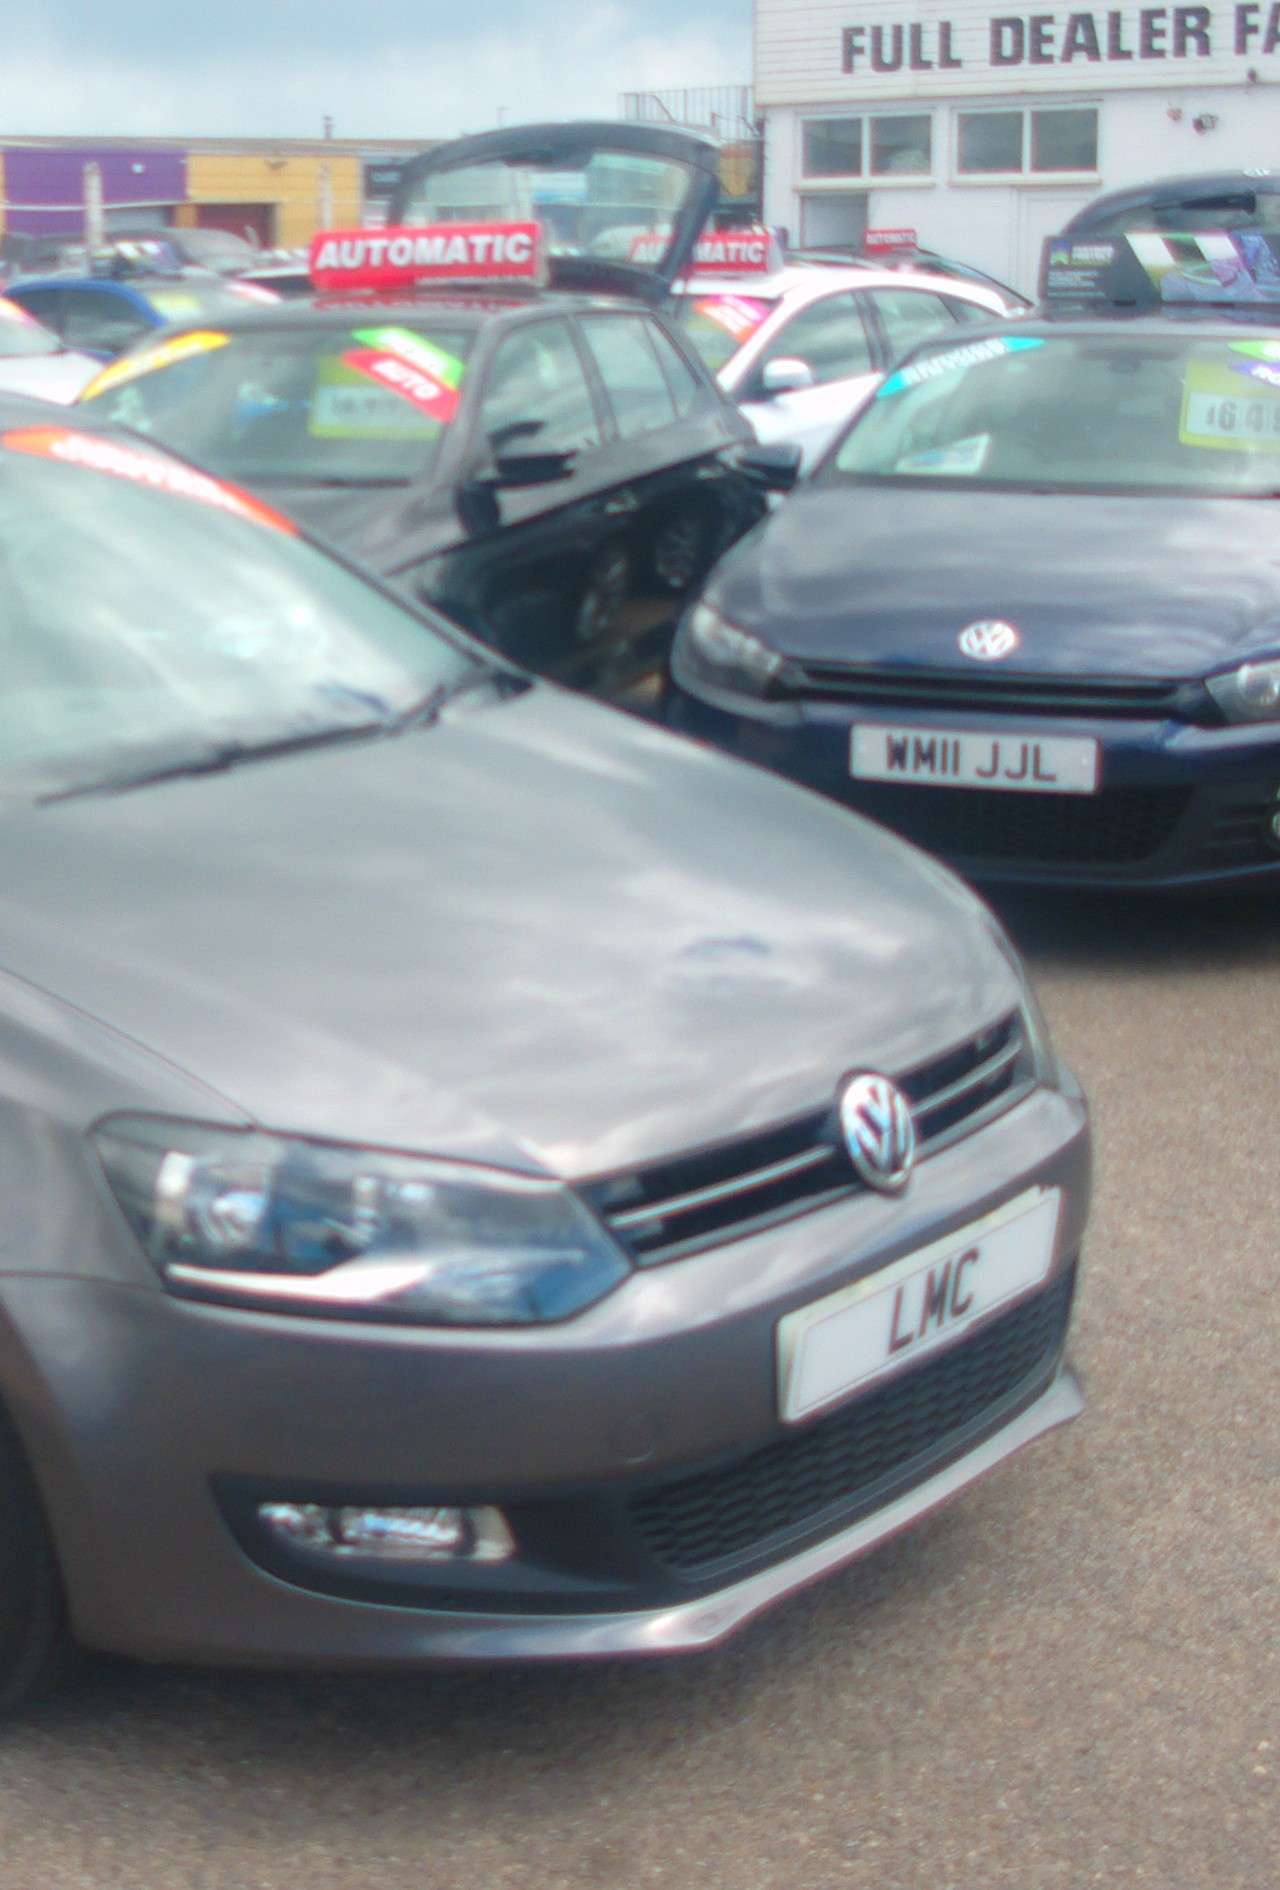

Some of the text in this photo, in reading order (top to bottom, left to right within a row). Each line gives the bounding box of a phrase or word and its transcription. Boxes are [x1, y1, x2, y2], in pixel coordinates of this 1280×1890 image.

[841, 21, 962, 74] FULL
[989, 6, 1211, 67] DEALER
[316, 233, 532, 270] AUTOMATIC
[632, 240, 764, 263] AUMATIC
[372, 359, 441, 401] AUTO
[885, 734, 1057, 782] WM11 JJL
[887, 1248, 980, 1355] LMC
